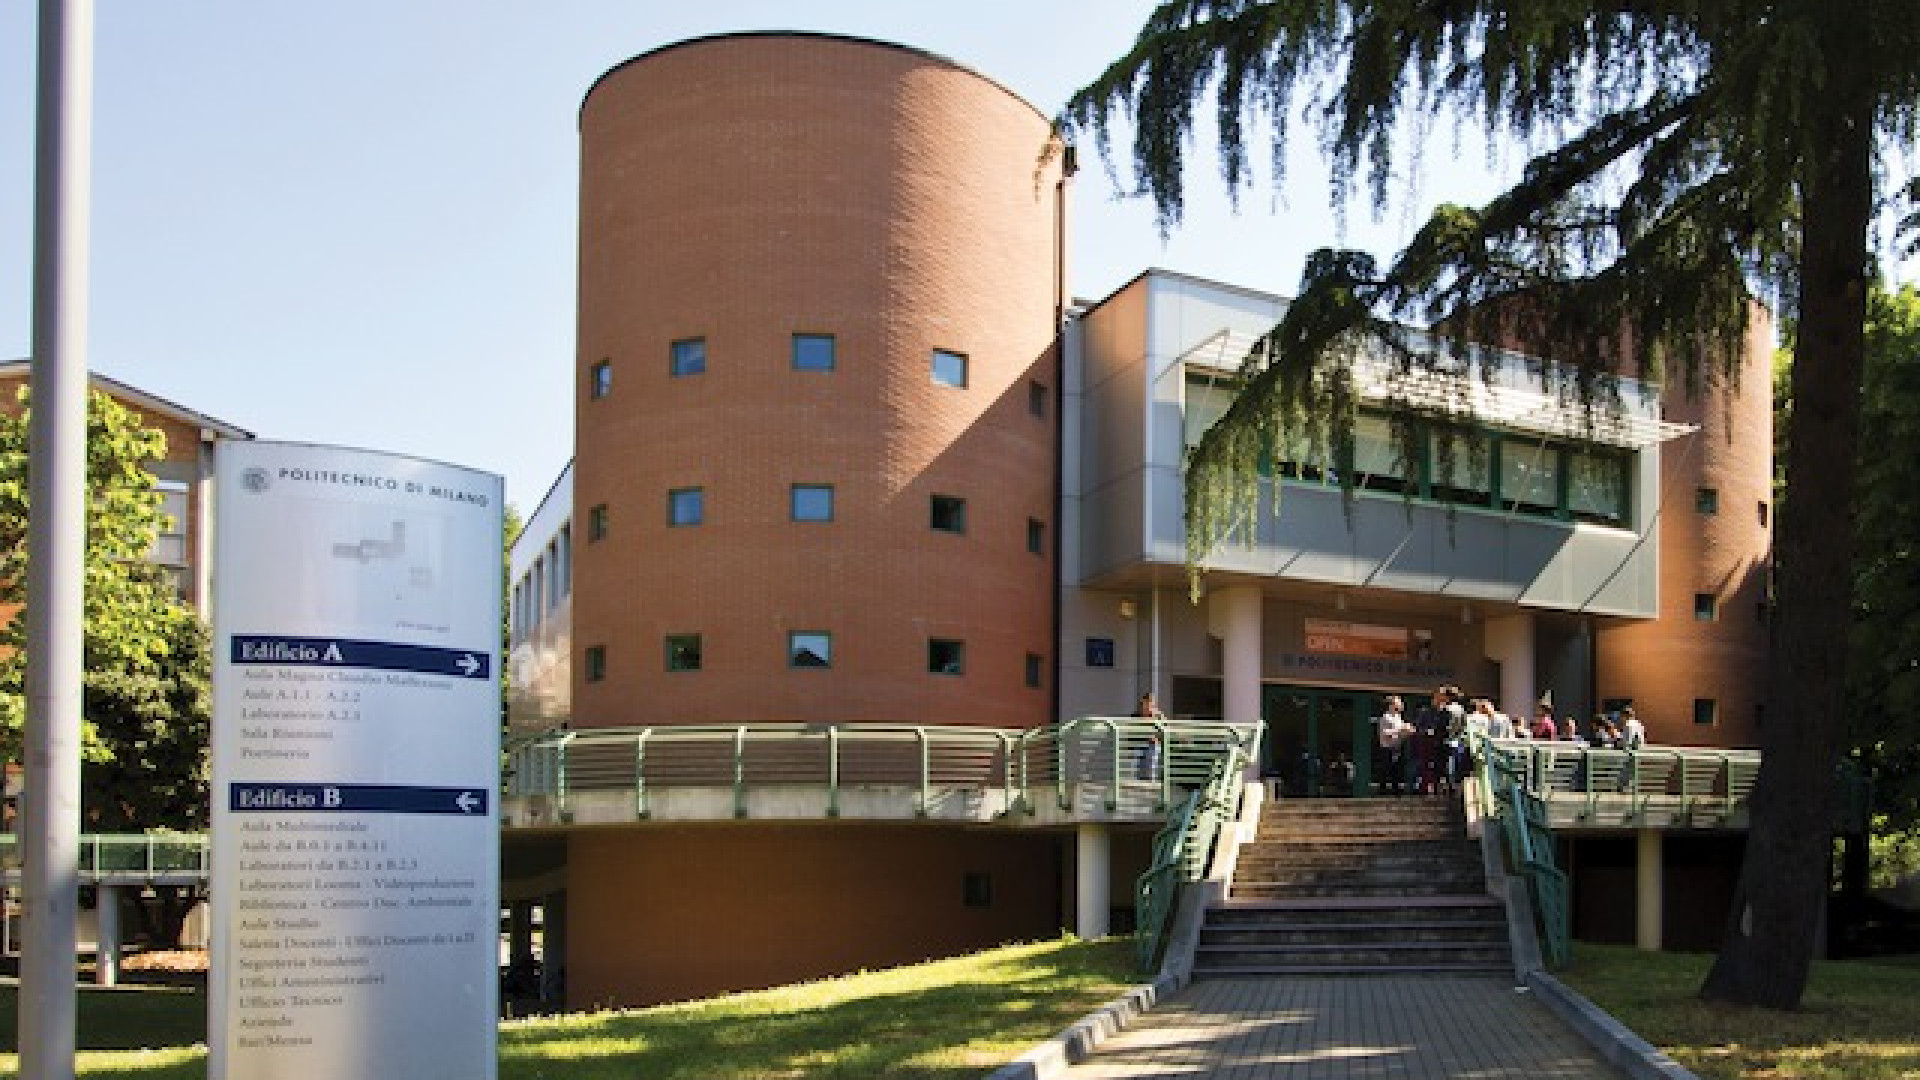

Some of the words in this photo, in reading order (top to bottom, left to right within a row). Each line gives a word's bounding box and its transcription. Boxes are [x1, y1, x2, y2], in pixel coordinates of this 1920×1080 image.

[278, 467, 399, 490] POLITECNICO
[405, 481, 423, 493] DI
[429, 485, 490, 507] MILANO
[241, 641, 319, 661] Edificio
[323, 641, 344, 661] A
[1298, 655, 1384, 674] POLITECNICO
[1388, 661, 1403, 675] DI
[1406, 663, 1456, 679] MILANO
[243, 668, 273, 681] Aula
[276, 669, 324, 683] Magna
[241, 707, 324, 720] Laboratorio
[240, 728, 268, 739] Sala
[240, 747, 309, 759] Portineria
[239, 788, 316, 808] Edificio
[323, 787, 342, 808] B
[276, 821, 368, 832] Multimediale
[240, 859, 312, 871] Laboratori
[240, 878, 312, 891] Laboratori
[273, 918, 319, 929] Studio
